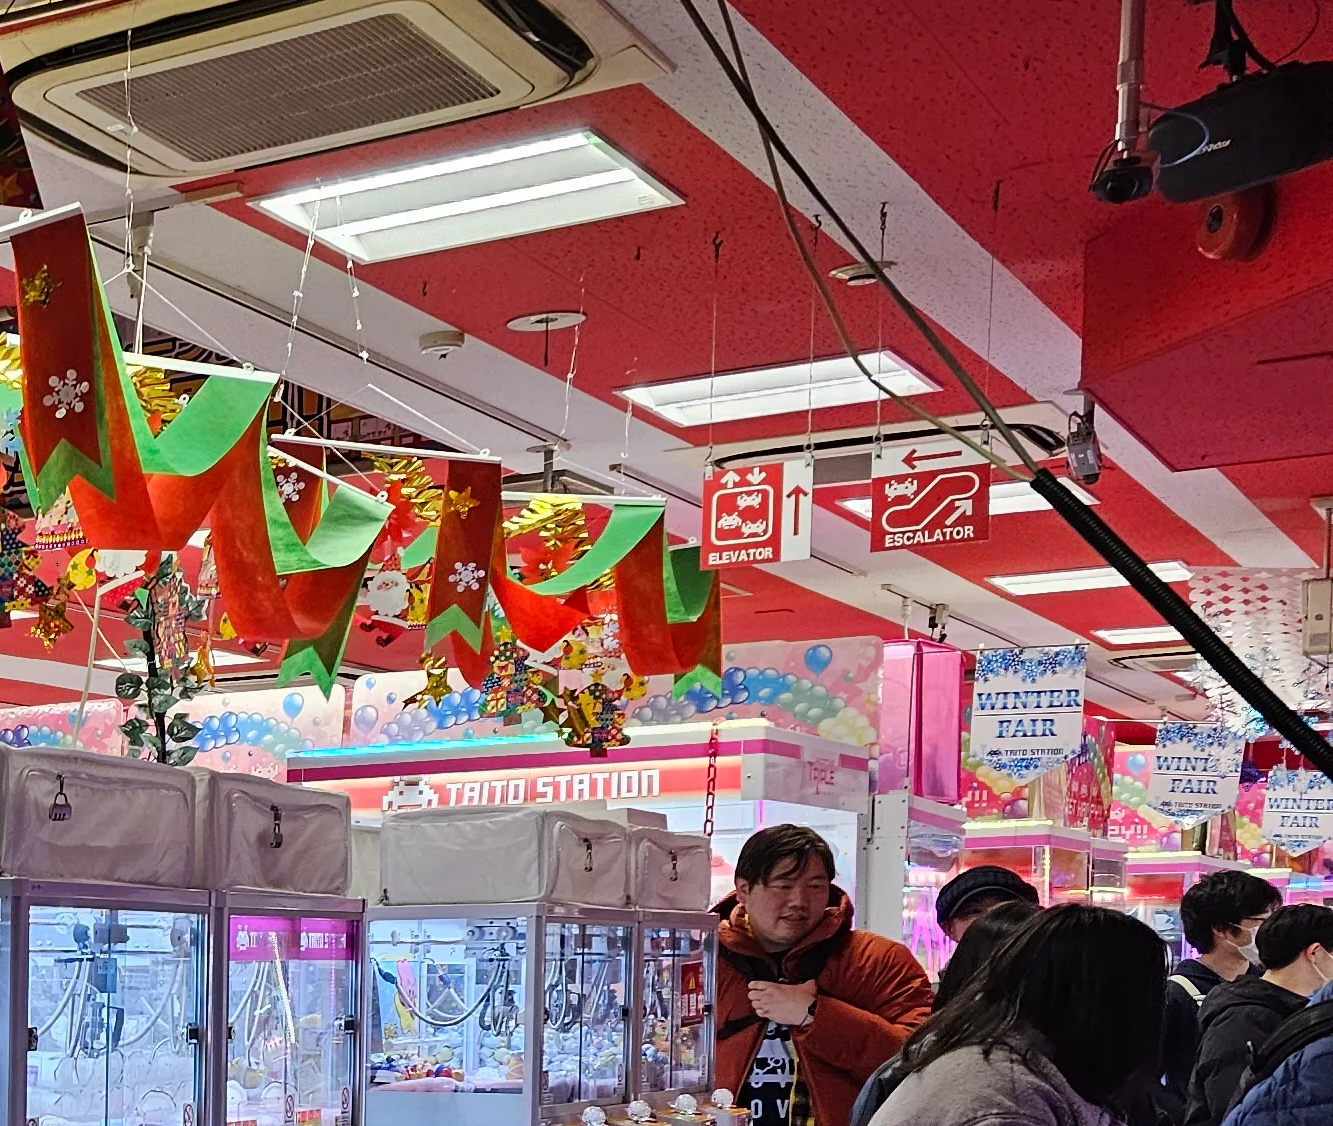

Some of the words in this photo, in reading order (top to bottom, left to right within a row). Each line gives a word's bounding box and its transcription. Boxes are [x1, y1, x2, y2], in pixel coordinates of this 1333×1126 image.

[884, 525, 974, 548] ESCALATOR
[708, 547, 773, 566] ELEVATOR
[976, 689, 1082, 711] WINTER
[994, 718, 1058, 739] FAIR
[1004, 749, 1028, 757] TAITO
[1030, 748, 1064, 756] STATION
[1155, 755, 1240, 772] WINTR
[446, 777, 526, 808] TAITO
[535, 768, 660, 802] STATION
[1168, 778, 1218, 795] FAIR
[1279, 815, 1321, 829] FAIR
